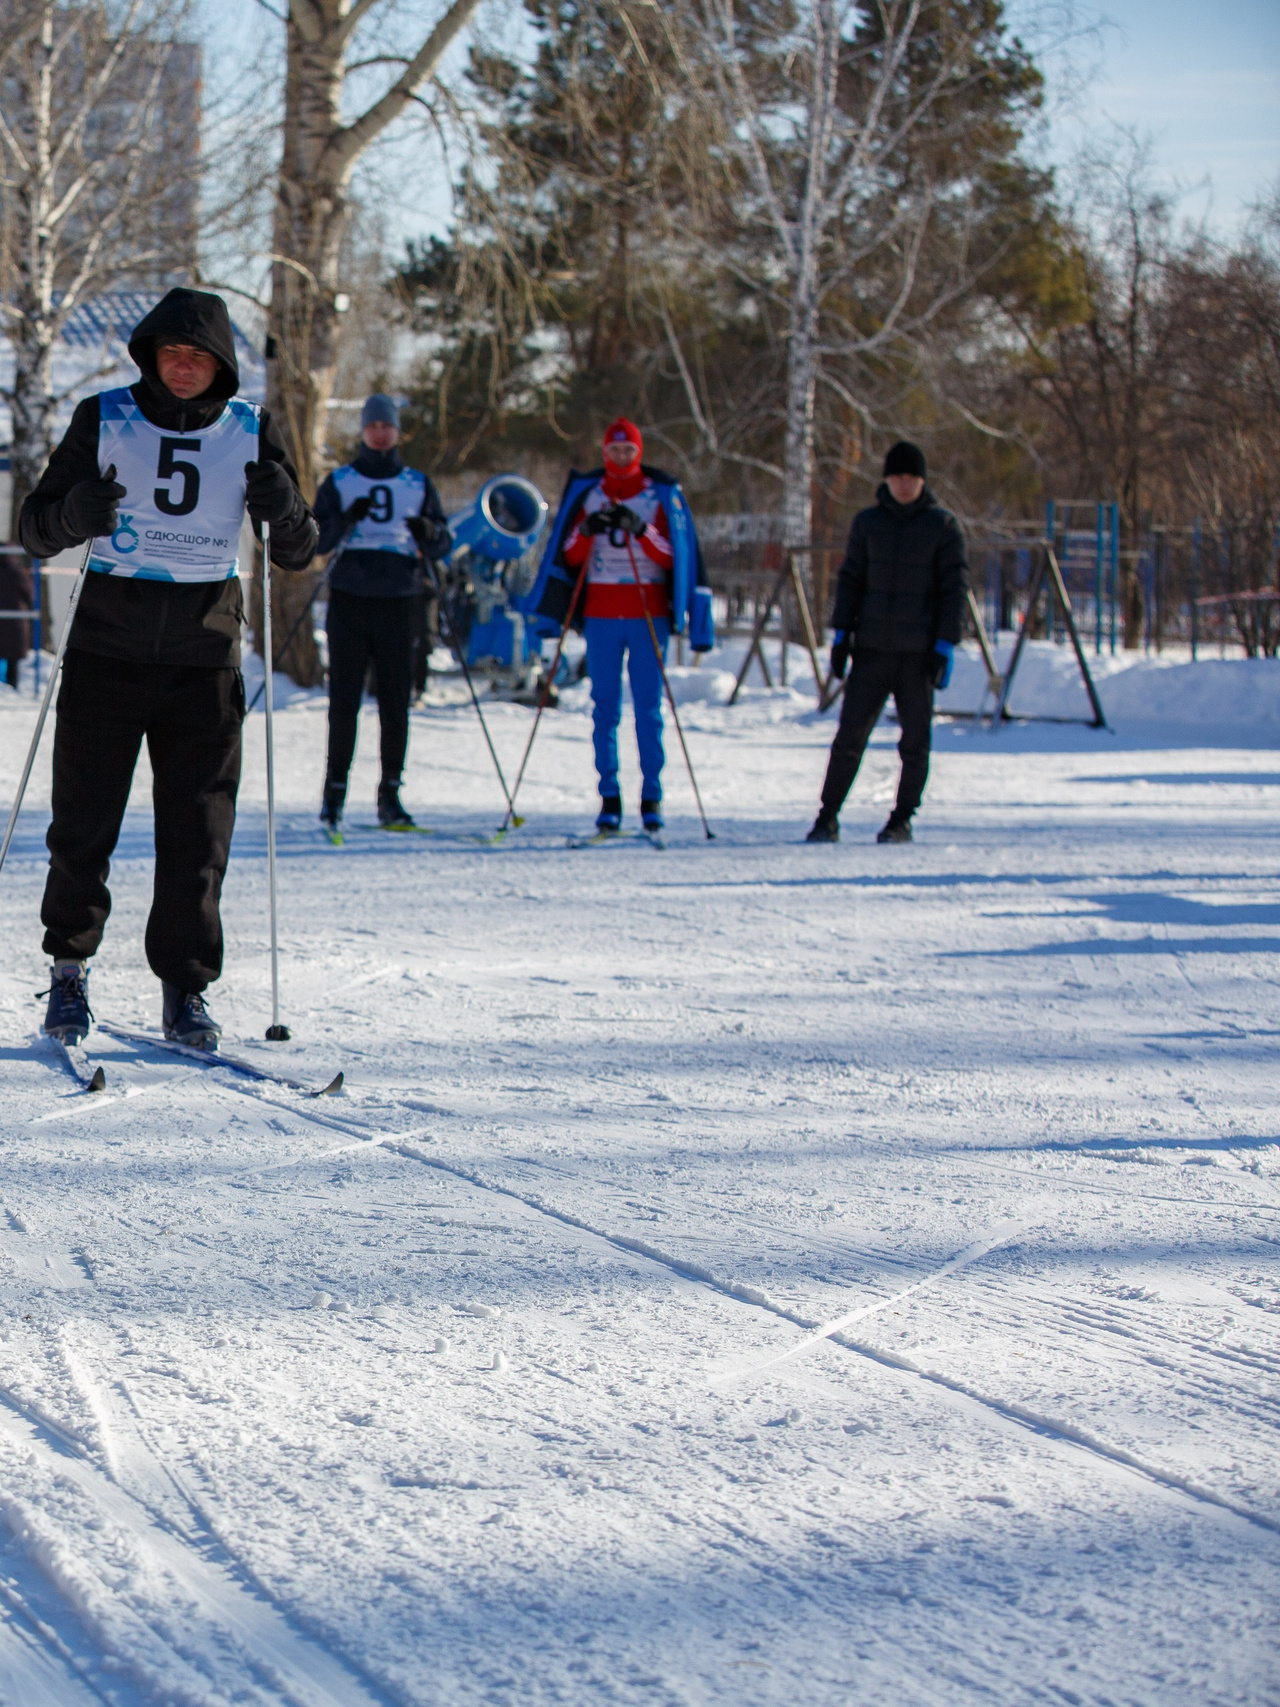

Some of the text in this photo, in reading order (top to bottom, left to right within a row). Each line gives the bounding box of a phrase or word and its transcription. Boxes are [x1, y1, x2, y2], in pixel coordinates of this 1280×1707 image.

[154, 436, 201, 516] 5
[370, 485, 393, 523] 9
[145, 530, 211, 546] СДЮСШОР
[212, 538, 229, 548] №2
